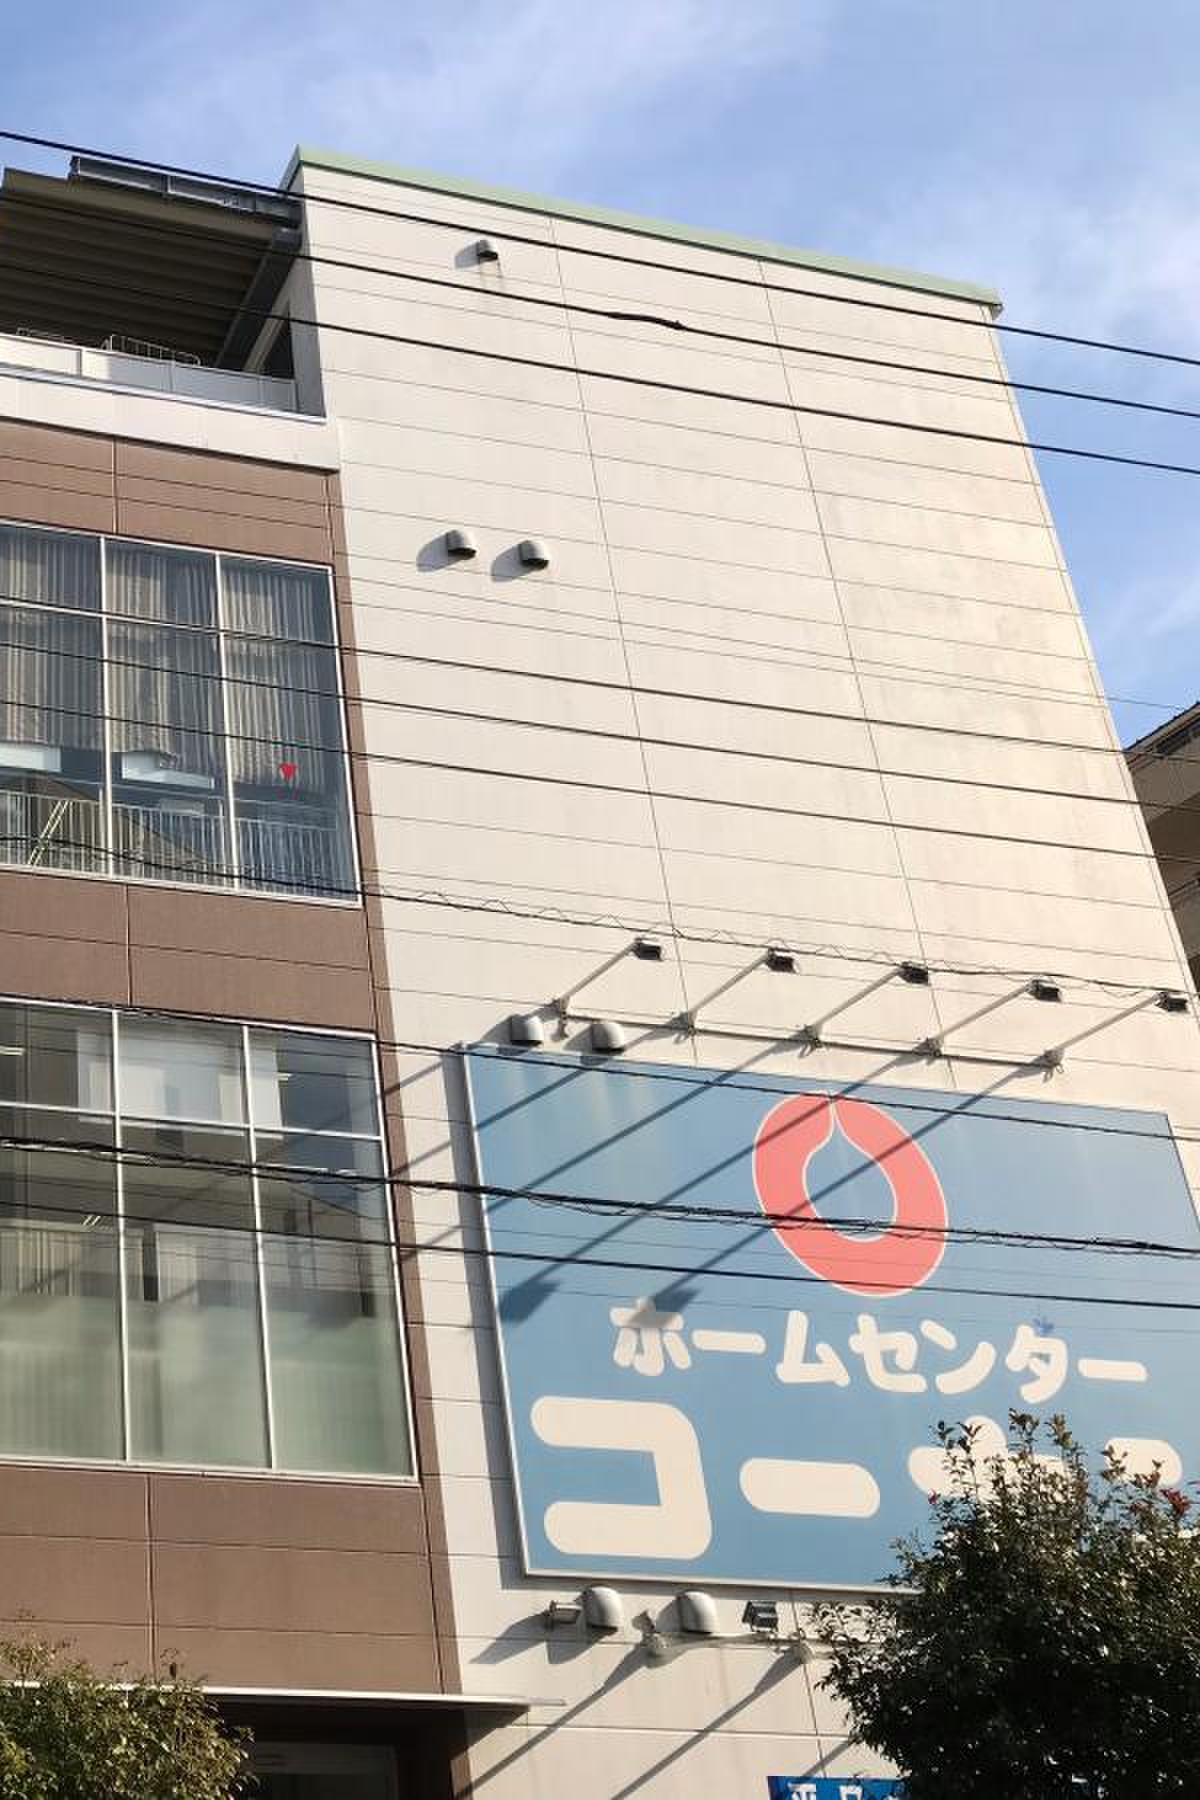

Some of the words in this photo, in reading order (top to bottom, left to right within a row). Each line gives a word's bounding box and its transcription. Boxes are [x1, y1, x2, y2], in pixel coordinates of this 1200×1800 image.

[610, 1297, 1148, 1403] ホームセンター
